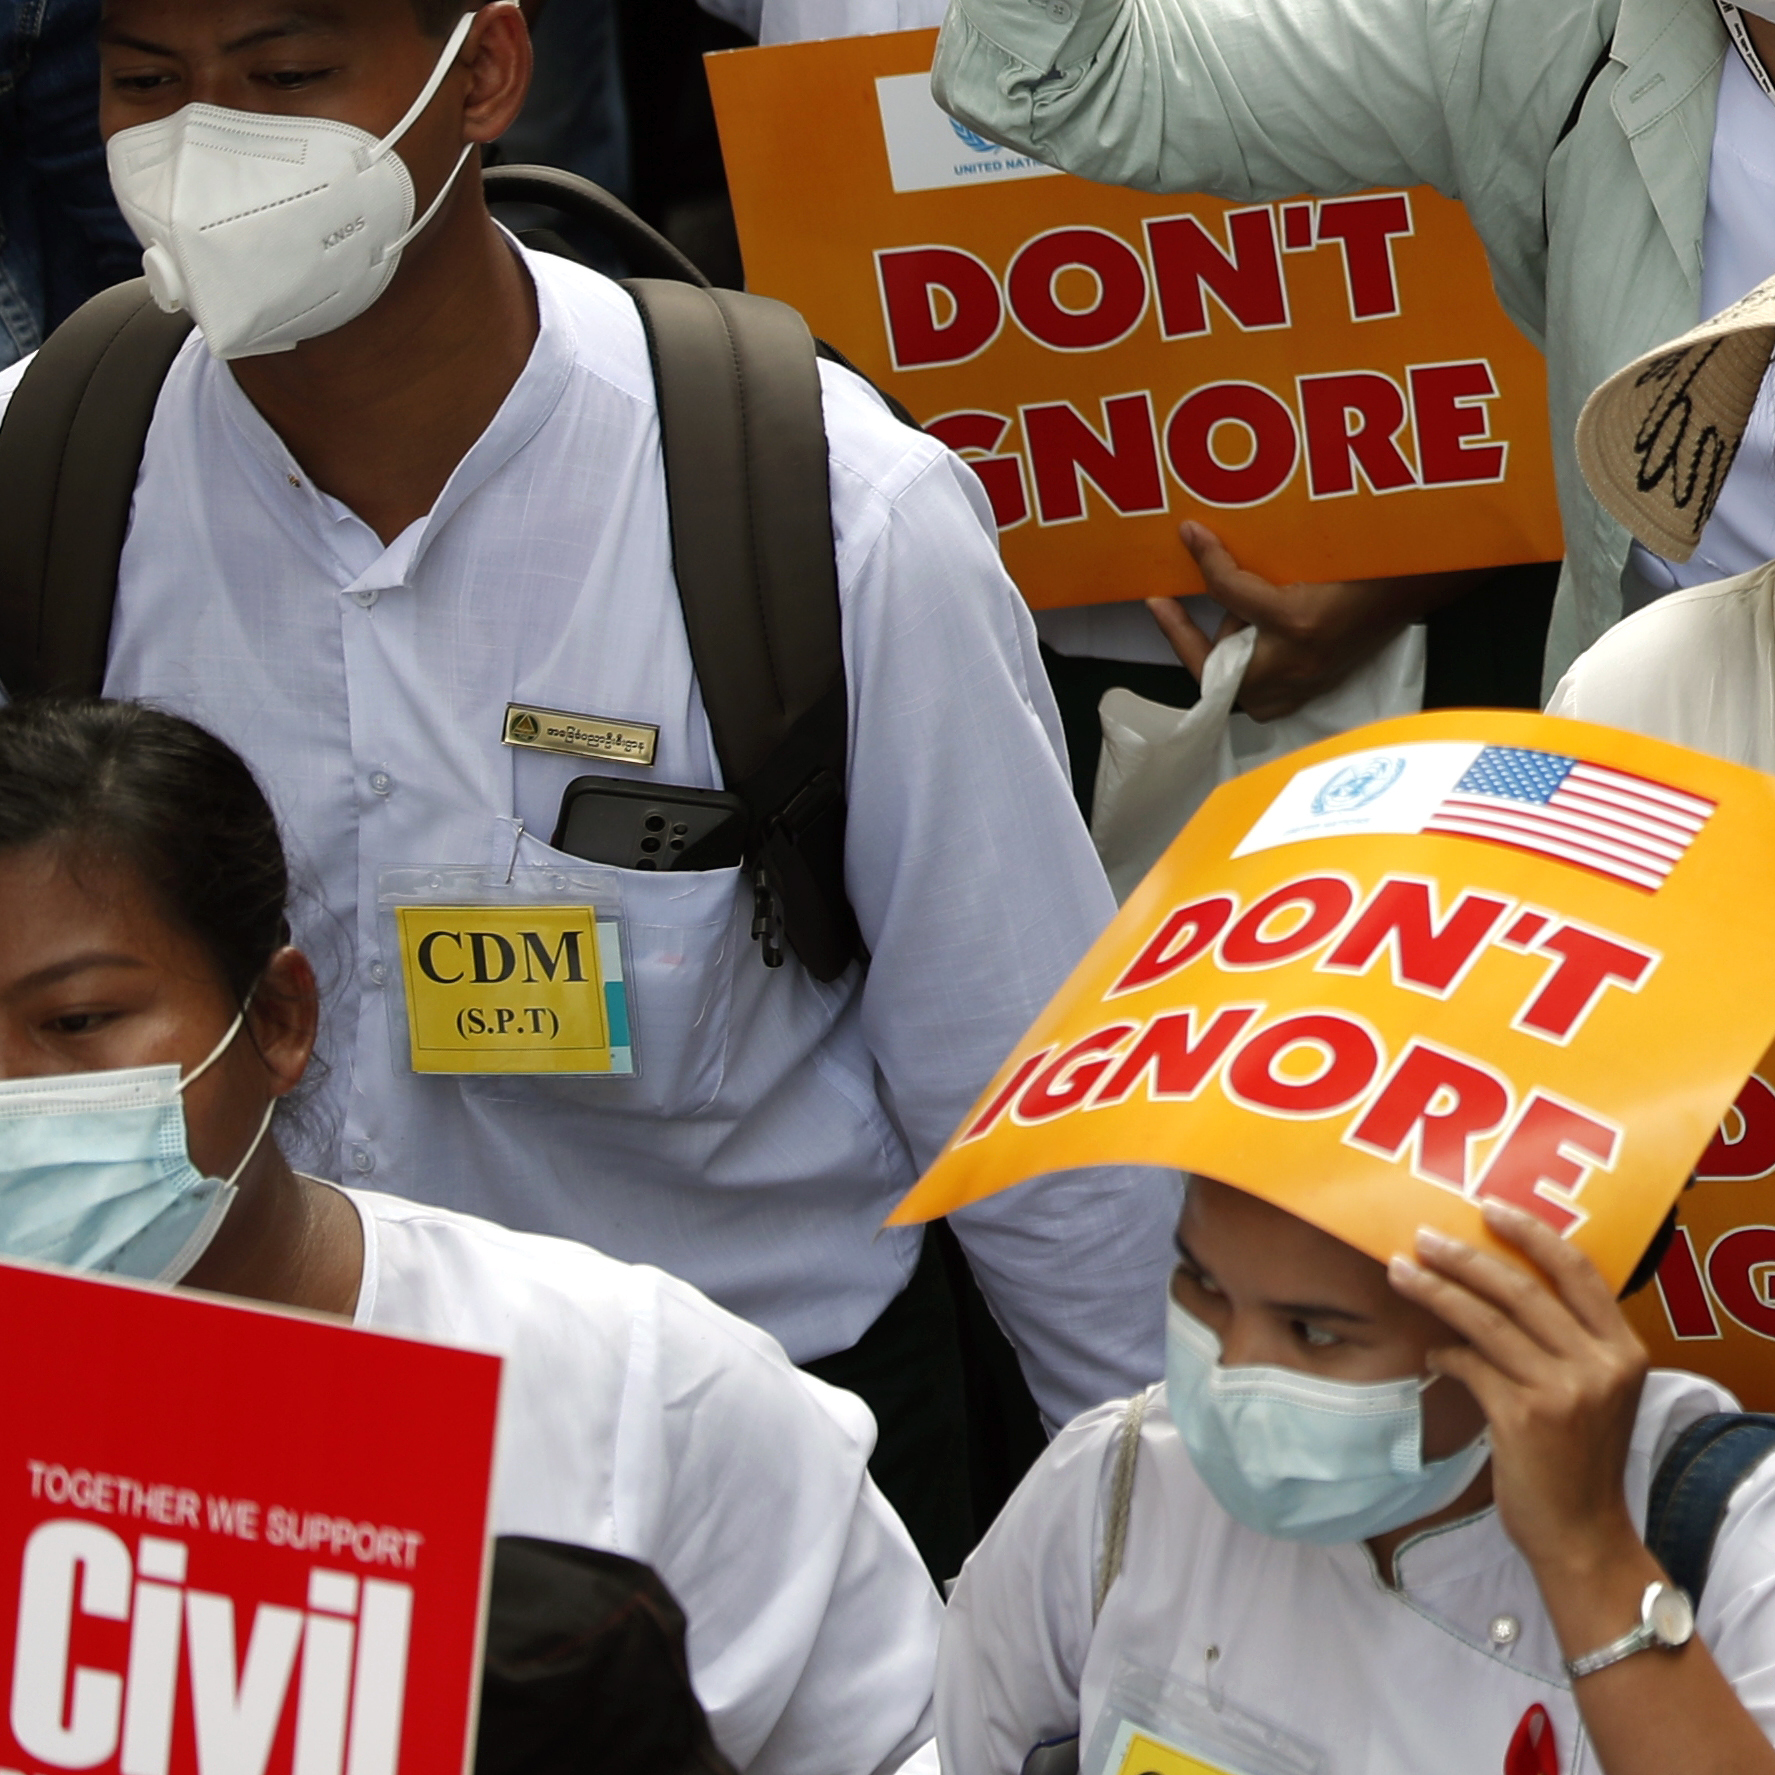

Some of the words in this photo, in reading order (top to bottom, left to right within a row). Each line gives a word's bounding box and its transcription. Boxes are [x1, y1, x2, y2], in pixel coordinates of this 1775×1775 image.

[322, 215, 366, 251] KN95
[953, 161, 1003, 177] UNITED
[874, 192, 1414, 372] DON'T
[918, 359, 1509, 531] GNORE
[417, 930, 588, 984] CDM
[456, 1007, 560, 1041] (S.P.T)
[1102, 873, 1661, 1047] DON'T
[951, 1001, 1624, 1238] IGNORE
[27, 1458, 201, 1528] TOGETHER
[207, 1493, 260, 1541] WE
[266, 1503, 425, 1569] SUPPORT
[9, 1516, 415, 1775] Civil
